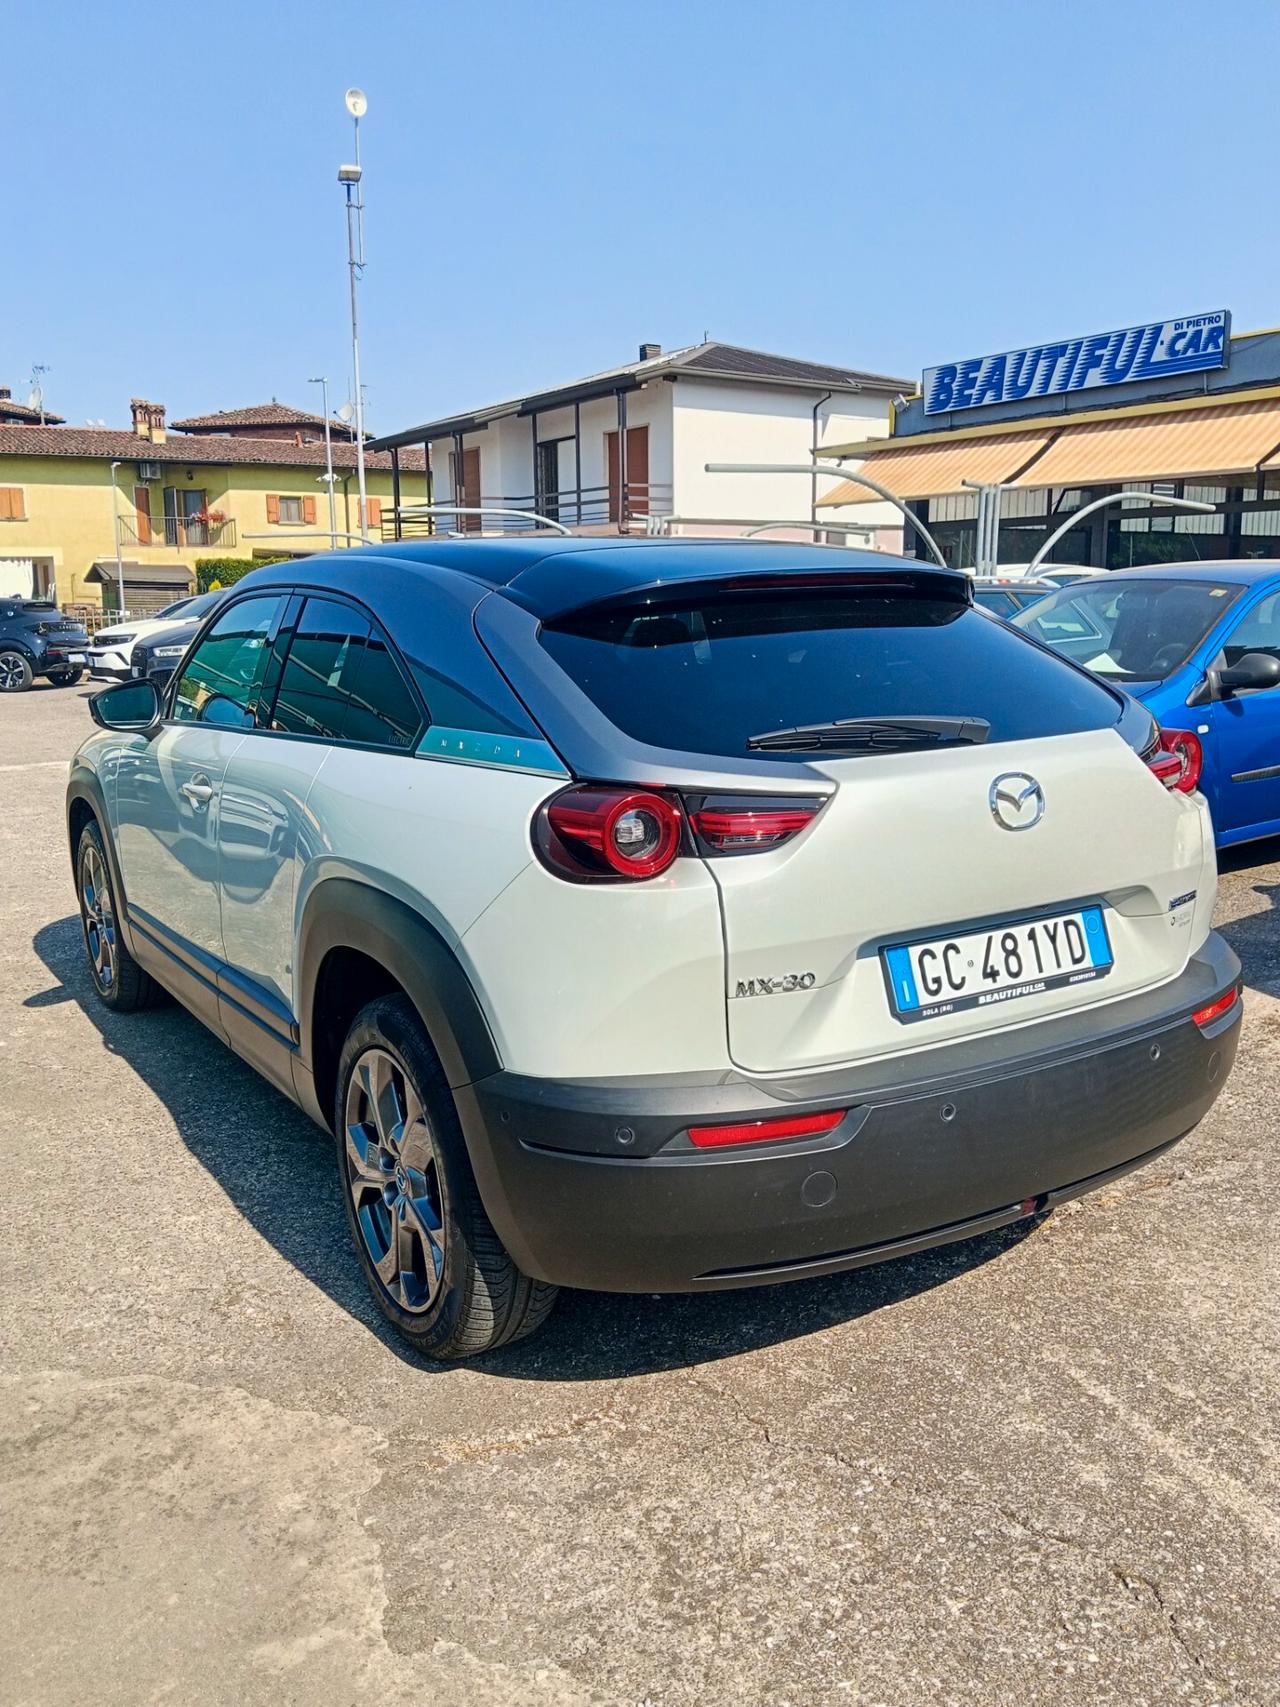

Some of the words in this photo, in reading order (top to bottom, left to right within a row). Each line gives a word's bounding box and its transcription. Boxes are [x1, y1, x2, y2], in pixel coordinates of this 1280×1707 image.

[1174, 322, 1184, 331] DI
[1187, 315, 1222, 329] PIETRO
[926, 325, 1164, 413] BEAUTIFUL
[1165, 325, 1224, 358] CAR
[918, 943, 966, 996] GC
[982, 919, 1086, 983] 481YD
[735, 972, 816, 998] MX-30
[978, 985, 1034, 1004] BEAUTIFUL
